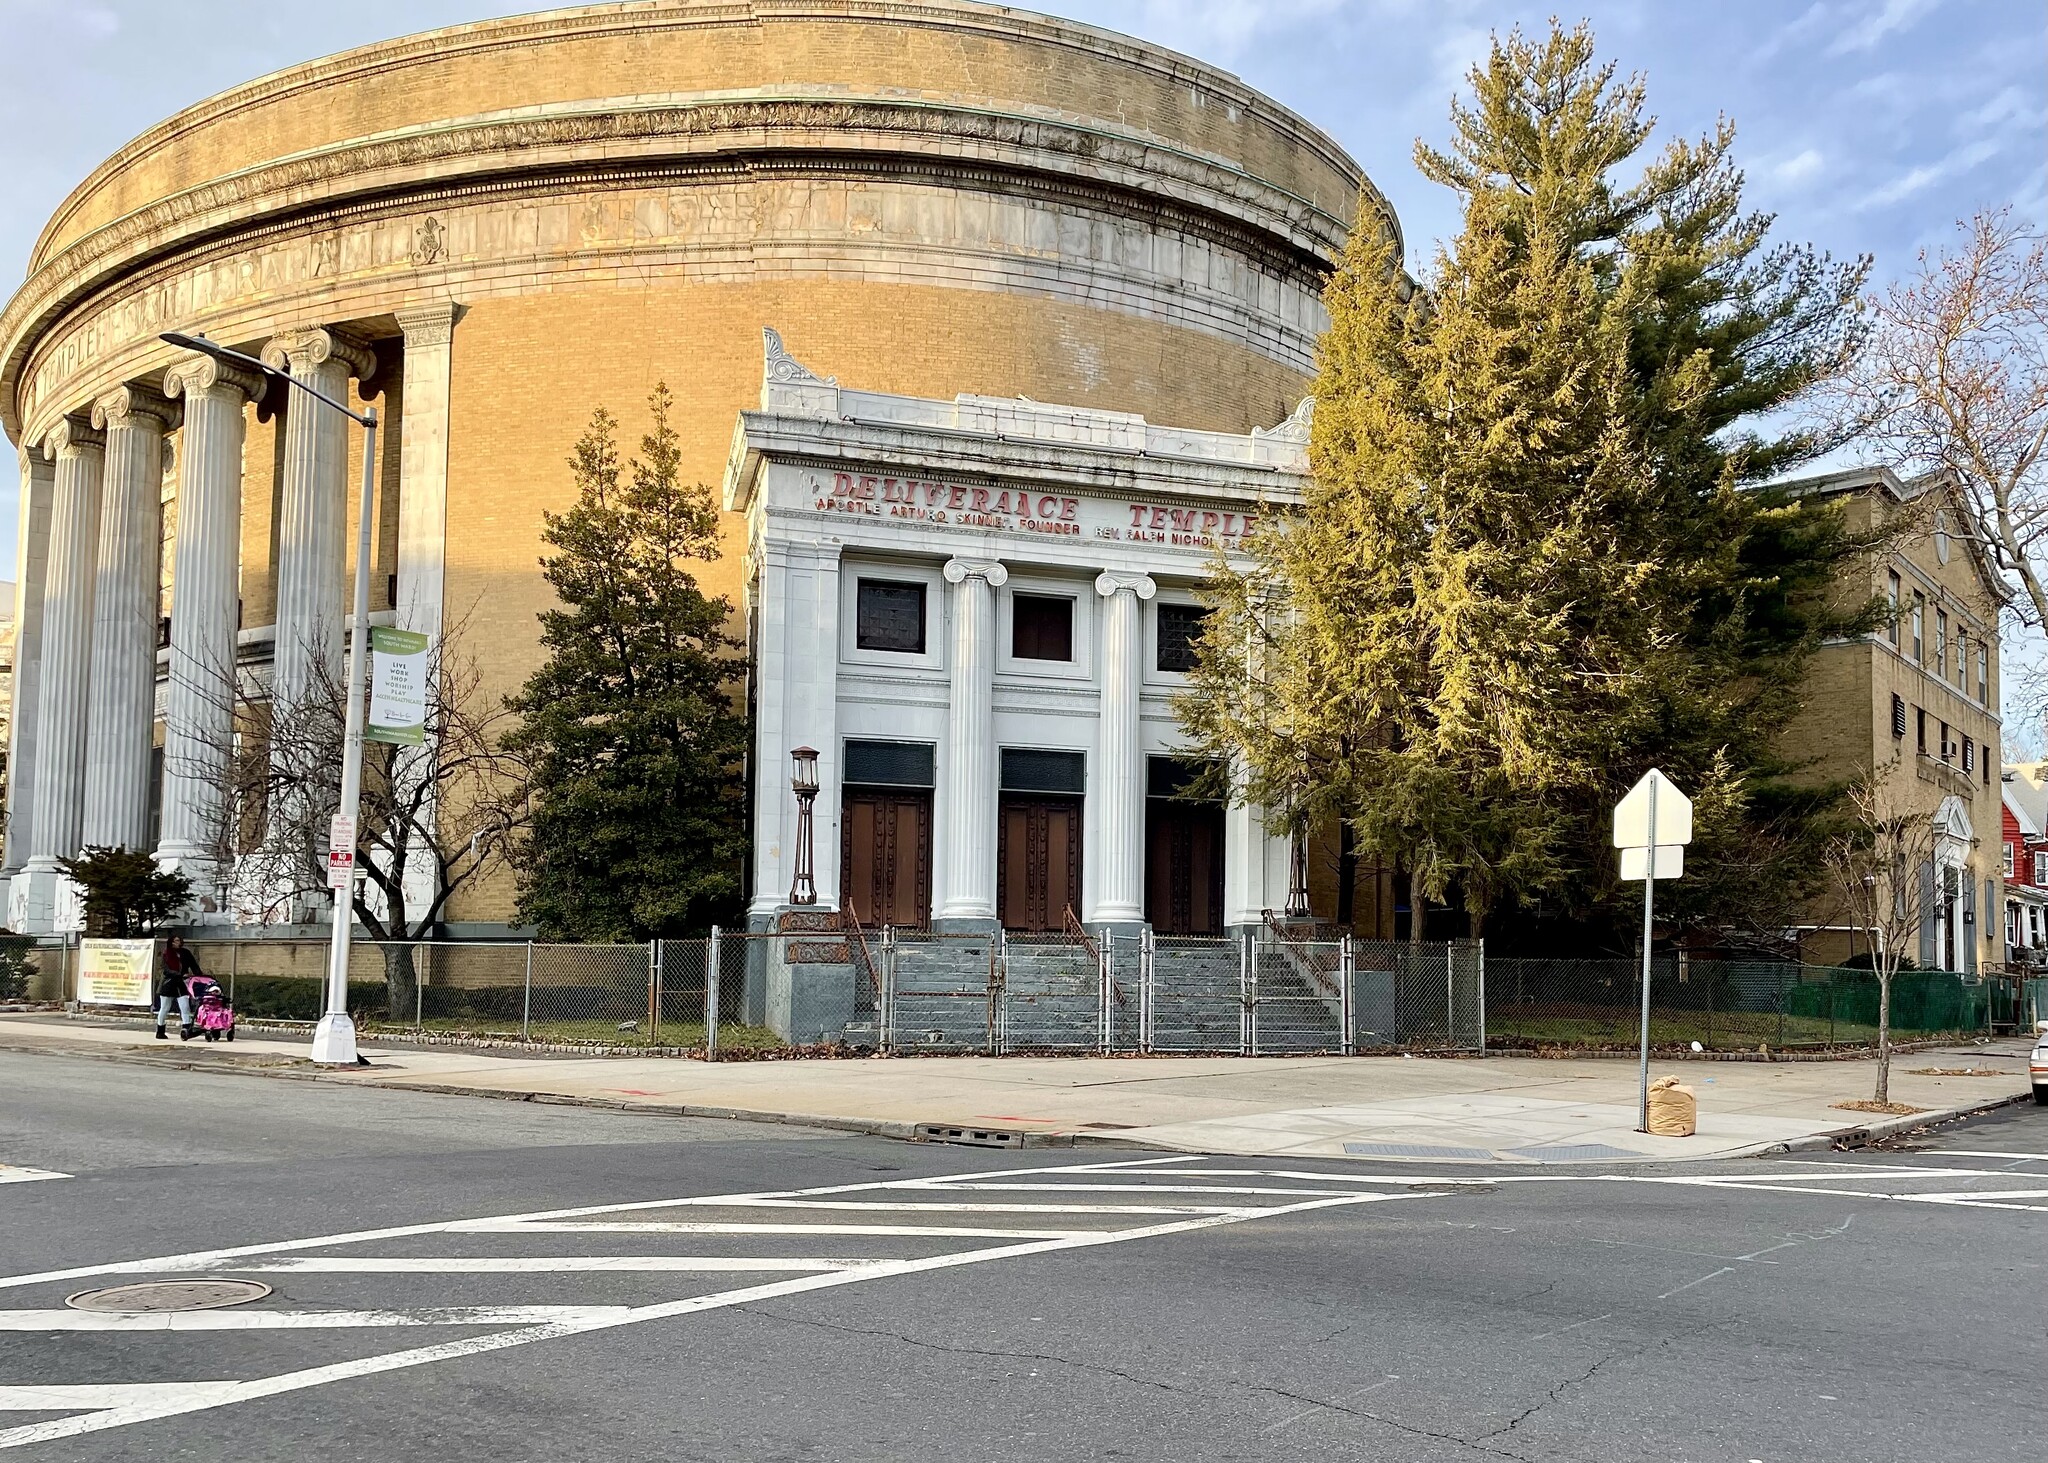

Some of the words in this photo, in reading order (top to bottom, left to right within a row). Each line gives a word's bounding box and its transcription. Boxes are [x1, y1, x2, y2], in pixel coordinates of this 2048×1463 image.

[42, 326, 96, 398] TEMPLE
[831, 472, 1079, 521] DELIVERANCE
[1130, 504, 1259, 537] TEMPLE
[815, 498, 880, 515] APOSTLE
[890, 505, 947, 522] ARTURO
[1019, 519, 1080, 534] FOUNDER
[1126, 529, 1165, 543] RALPH
[392, 662, 406, 670] LIVE
[390, 668, 409, 676] WORK
[391, 675, 408, 683] SHOP
[385, 681, 414, 690] WORSHIP
[391, 696, 422, 705] HEALTHCARE
[330, 859, 352, 867] PARKING
